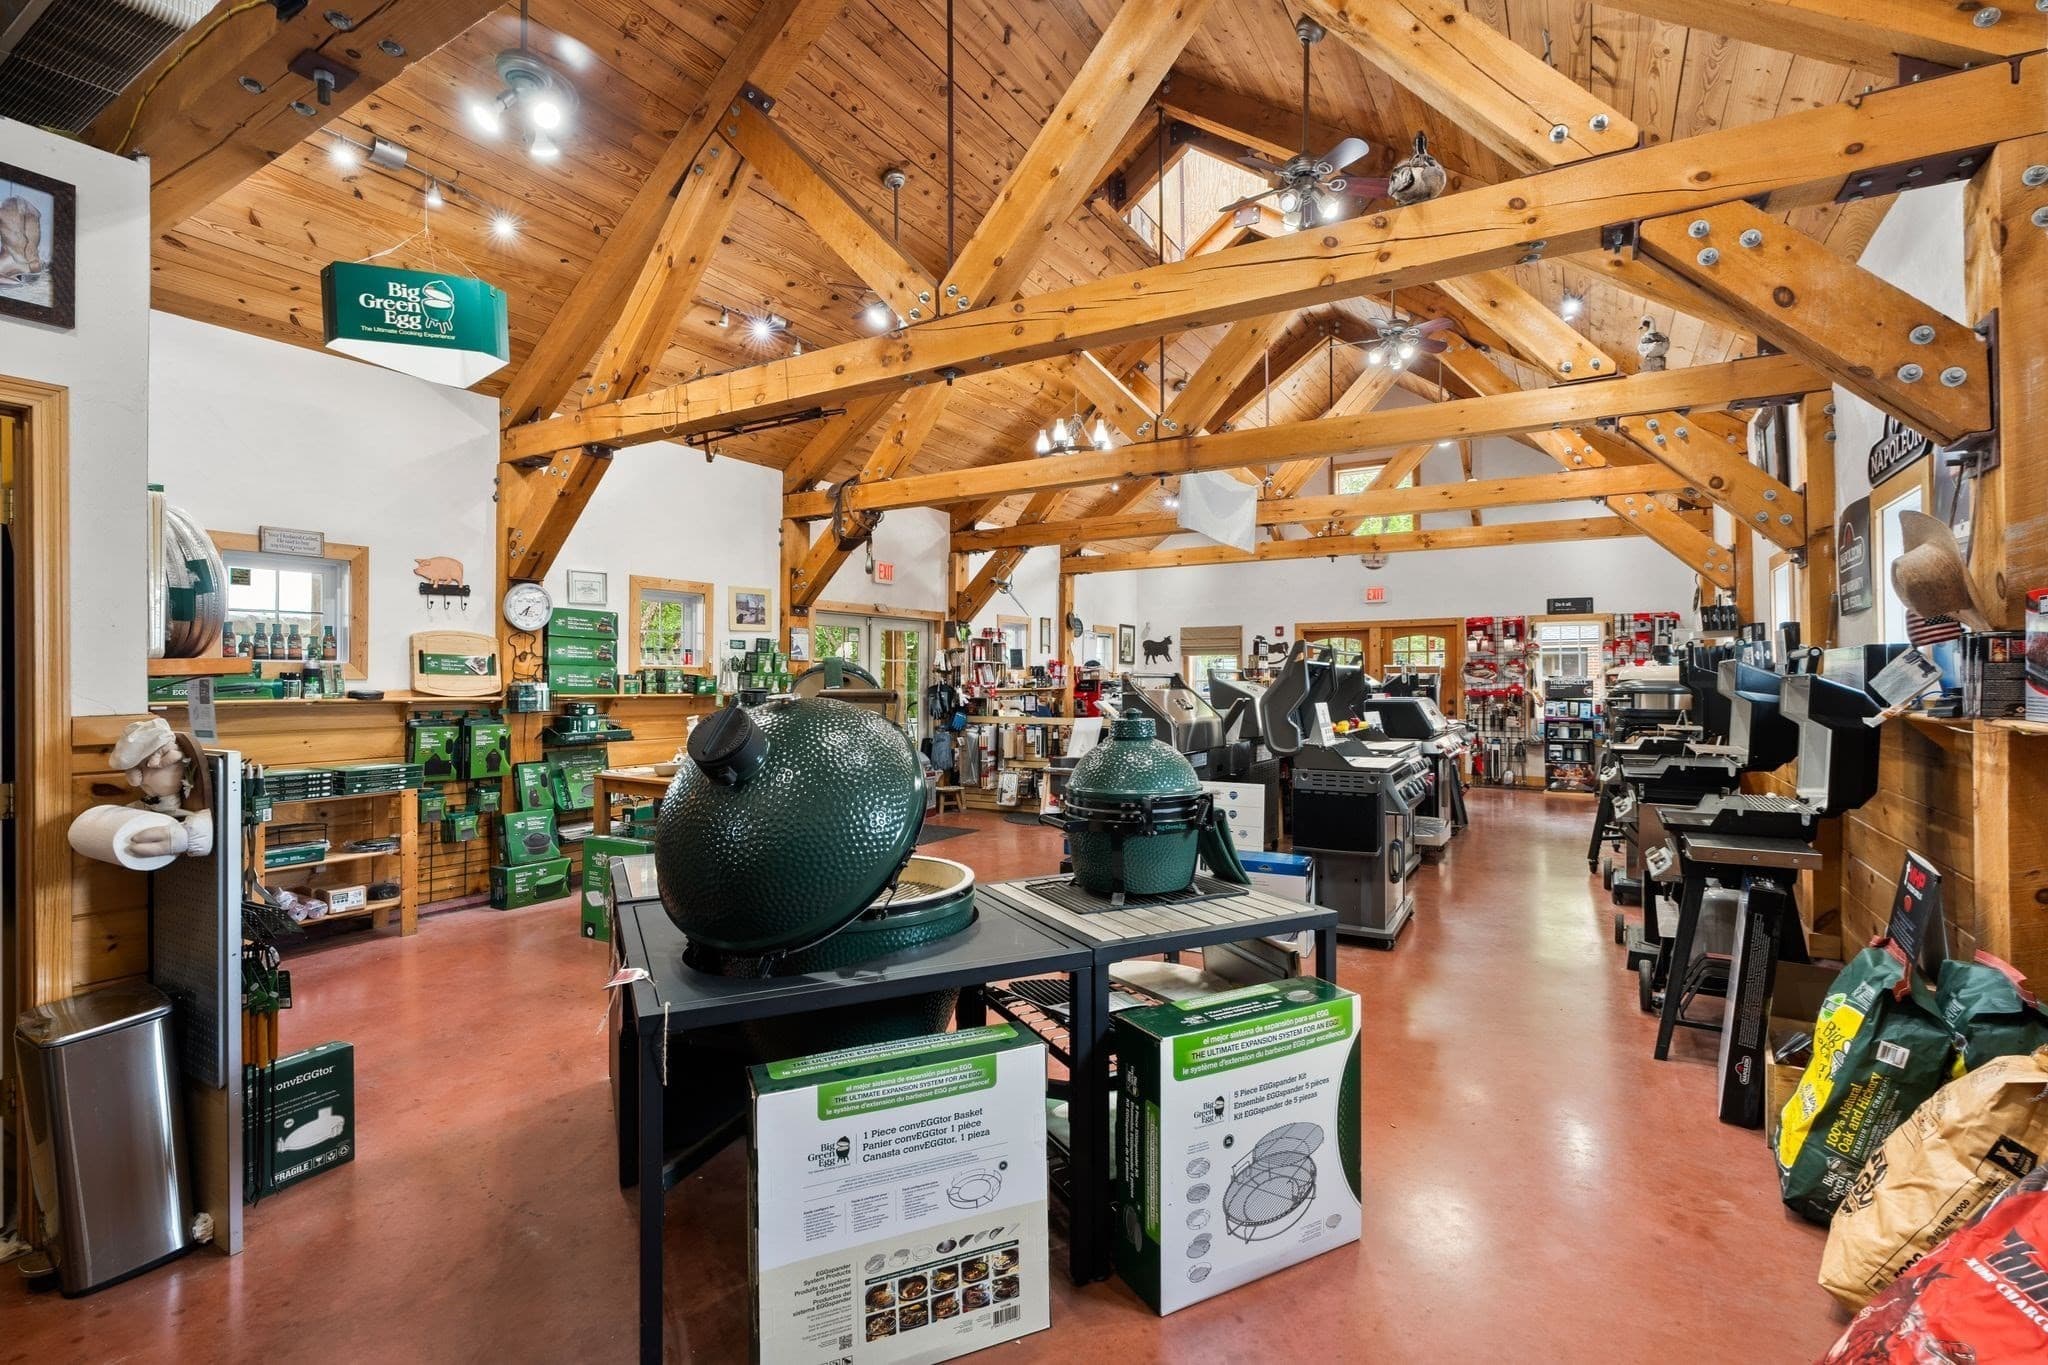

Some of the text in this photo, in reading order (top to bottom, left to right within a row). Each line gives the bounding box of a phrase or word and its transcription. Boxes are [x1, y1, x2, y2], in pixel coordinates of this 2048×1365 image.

[388, 281, 420, 301] Big
[359, 292, 421, 313] Green
[384, 309, 422, 329] Egg
[373, 326, 398, 335] Ultimate
[398, 329, 423, 338] Cooking
[423, 331, 456, 340] Experience
[1871, 428, 1922, 477] NAPOLEON
[878, 563, 894, 581] EXIT
[1366, 588, 1384, 601] EXIT
[1203, 1036, 1209, 1045] el
[1210, 1034, 1229, 1044] mejor
[1230, 1028, 1254, 1038] sistema
[1255, 1025, 1263, 1033] de
[1263, 1018, 1294, 1032] expansión
[1295, 1015, 1308, 1025] para
[1316, 1009, 1329, 1018] EGG
[809, 1052, 855, 1065] ULTIMATE
[857, 1042, 905, 1056] EXPANSION
[907, 1037, 942, 1046] SYSTEM
[1192, 1050, 1206, 1060] THE
[1206, 1043, 1240, 1057] ULTIMATE
[1240, 1034, 1278, 1049] EXPANSION
[1278, 1028, 1302, 1040] SYSTEM
[1303, 1024, 1315, 1033] FOR
[1182, 1068, 1189, 1076] le
[1190, 1062, 1218, 1075] système
[1219, 1052, 1255, 1067] d'extension
[1255, 1050, 1264, 1058] du
[835, 1095, 848, 1104] THE
[849, 1091, 881, 1101] ULTIMATE
[882, 1083, 918, 1096] EXPANSION
[919, 1078, 944, 1088] SYSTEM
[945, 1075, 958, 1083] FOR
[852, 1082, 872, 1091] mejor
[872, 1078, 896, 1088] sistema
[905, 1071, 936, 1083] expansión
[1234, 1072, 1307, 1098] 5 Piece EGGspander Kit
[833, 1104, 860, 1115] système
[860, 1098, 896, 1110] d'extension
[1203, 1102, 1214, 1110] Big
[1233, 1095, 1266, 1110] Ensemble
[1266, 1085, 1305, 1101] EGGspander
[1233, 1111, 1244, 1121] Kit
[1244, 1101, 1284, 1118] EGGspander
[1284, 1097, 1293, 1105] de
[1298, 1091, 1318, 1104] piezas
[1194, 1109, 1214, 1119] Green
[1201, 1115, 1214, 1124] Egg
[1825, 1082, 1863, 1147] 100% Natural
[1838, 1071, 1881, 1153] Oak and Hickory
[863, 1107, 984, 1140] 1 Piece convEGGtor Basket
[862, 1118, 982, 1151] Panier convEGGtor 1 pièce
[1852, 1128, 1867, 1158] PREMIUM
[820, 1142, 835, 1152] Big
[862, 1149, 900, 1163] Canasta
[961, 1133, 966, 1142] 1
[967, 1128, 991, 1141] pieza
[1995, 1144, 2020, 1166] X
[807, 1151, 835, 1162] Green
[818, 1157, 836, 1168] Egg
[274, 1162, 309, 1182] FRAGILE
[1822, 1170, 1839, 1188] Big
[1827, 1176, 1847, 1202] Green
[1941, 1213, 1954, 1229] THE
[1952, 1199, 1970, 1218] WOOD
[803, 1269, 851, 1286] System Products
[816, 1263, 851, 1277] EGGspander
